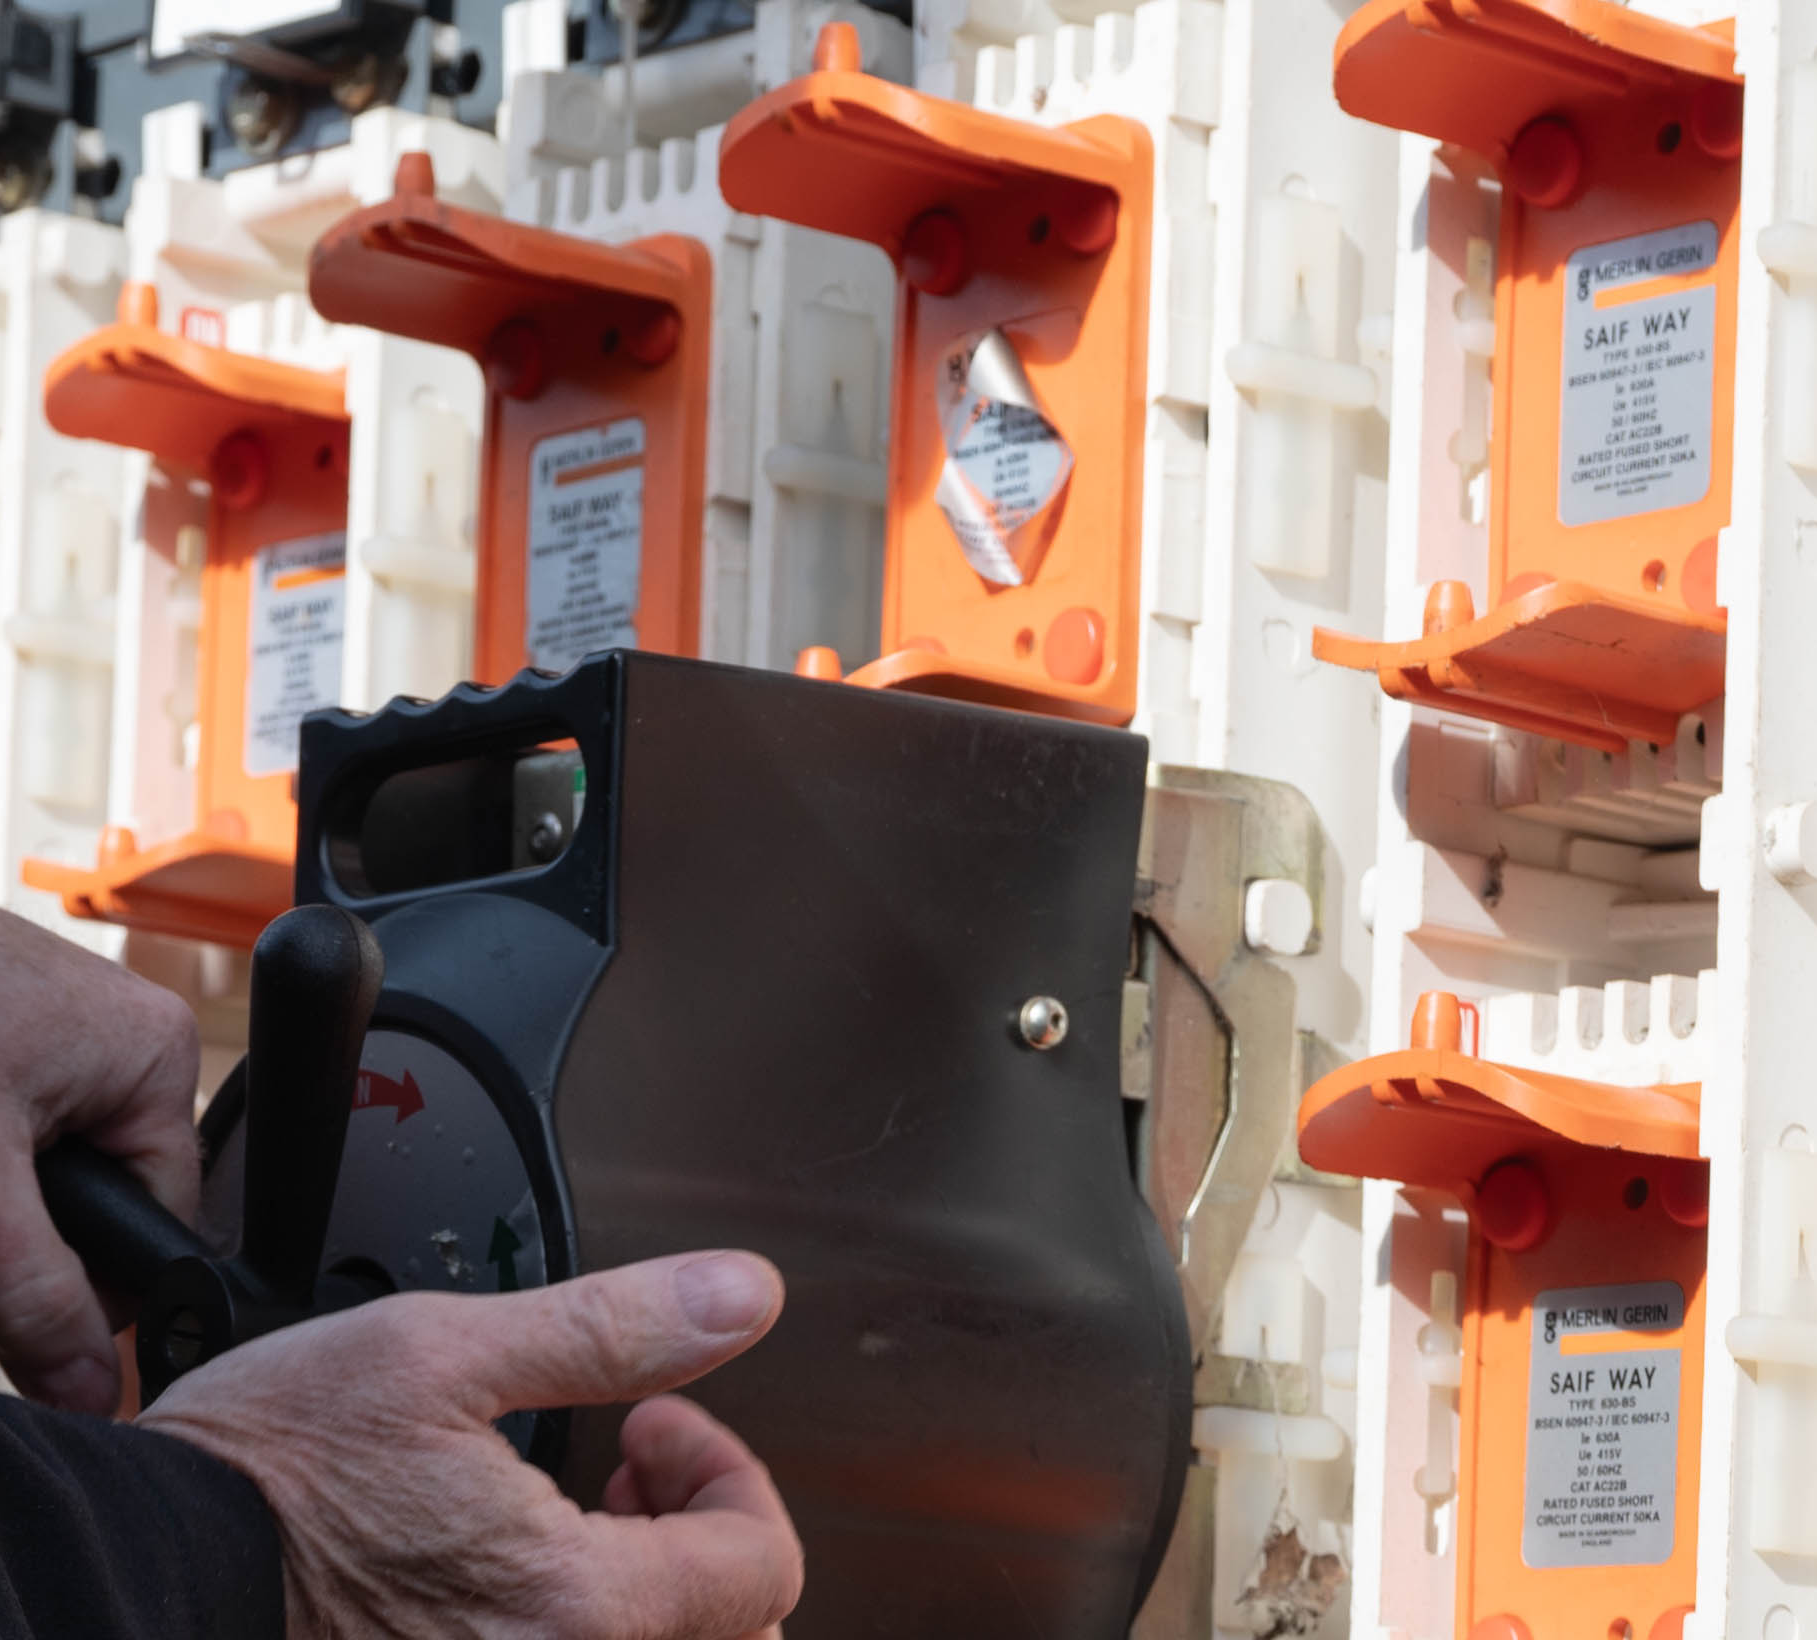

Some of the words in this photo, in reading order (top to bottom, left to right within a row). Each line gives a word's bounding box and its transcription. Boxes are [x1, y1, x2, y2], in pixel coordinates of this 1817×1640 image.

[1584, 320, 1628, 349] SAIF
[1642, 307, 1690, 336] WAY
[1562, 1306, 1617, 1327] MERLIN
[1623, 1303, 1668, 1324] GERIN
[1550, 1370, 1594, 1394] SAIF
[1609, 1366, 1655, 1390] WAY
[1543, 1497, 1577, 1509] RATED
[1580, 1496, 1614, 1508] FUSED
[1618, 1494, 1653, 1507] SHORT
